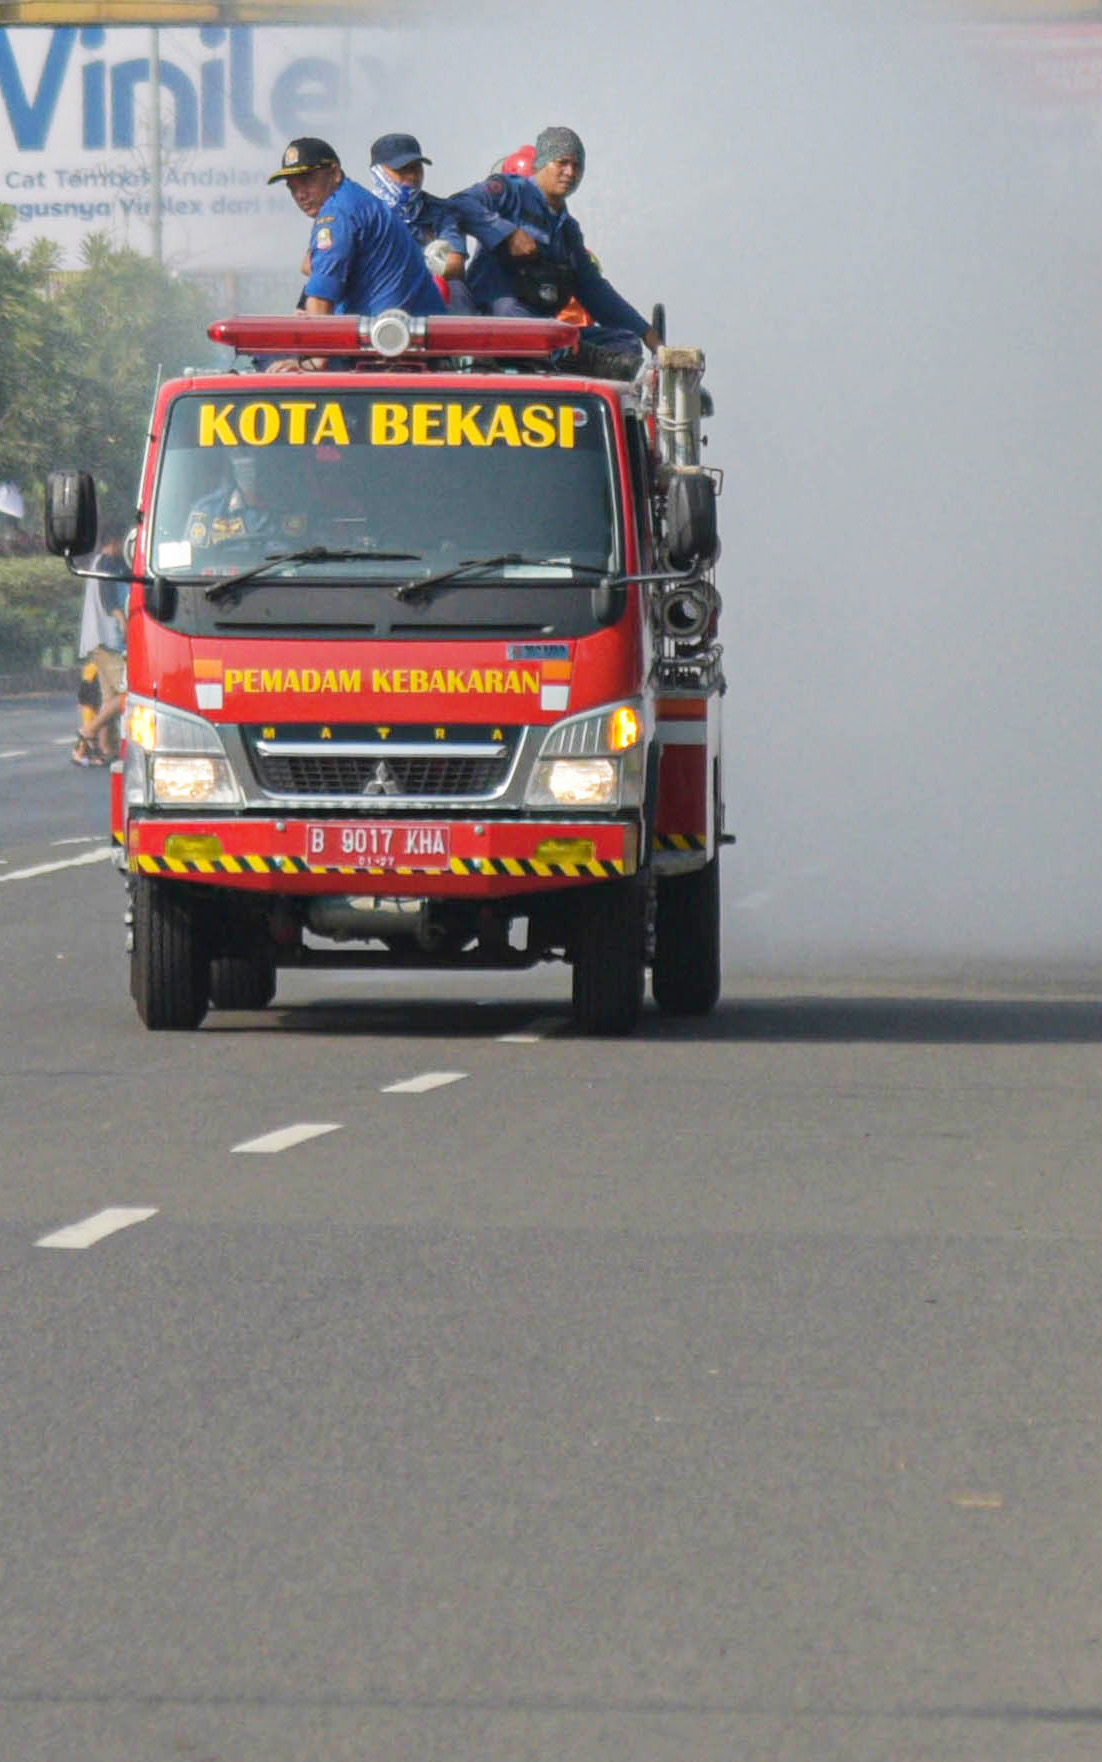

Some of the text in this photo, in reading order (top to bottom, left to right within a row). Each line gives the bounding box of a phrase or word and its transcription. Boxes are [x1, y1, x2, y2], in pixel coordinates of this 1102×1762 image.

[5, 170, 45, 189] Cat
[211, 196, 261, 215] dari
[199, 401, 576, 449] KOTA BEKASI
[223, 668, 541, 695] PEMADAM KEBAKARAN
[311, 827, 446, 855] B 9017 KHA
